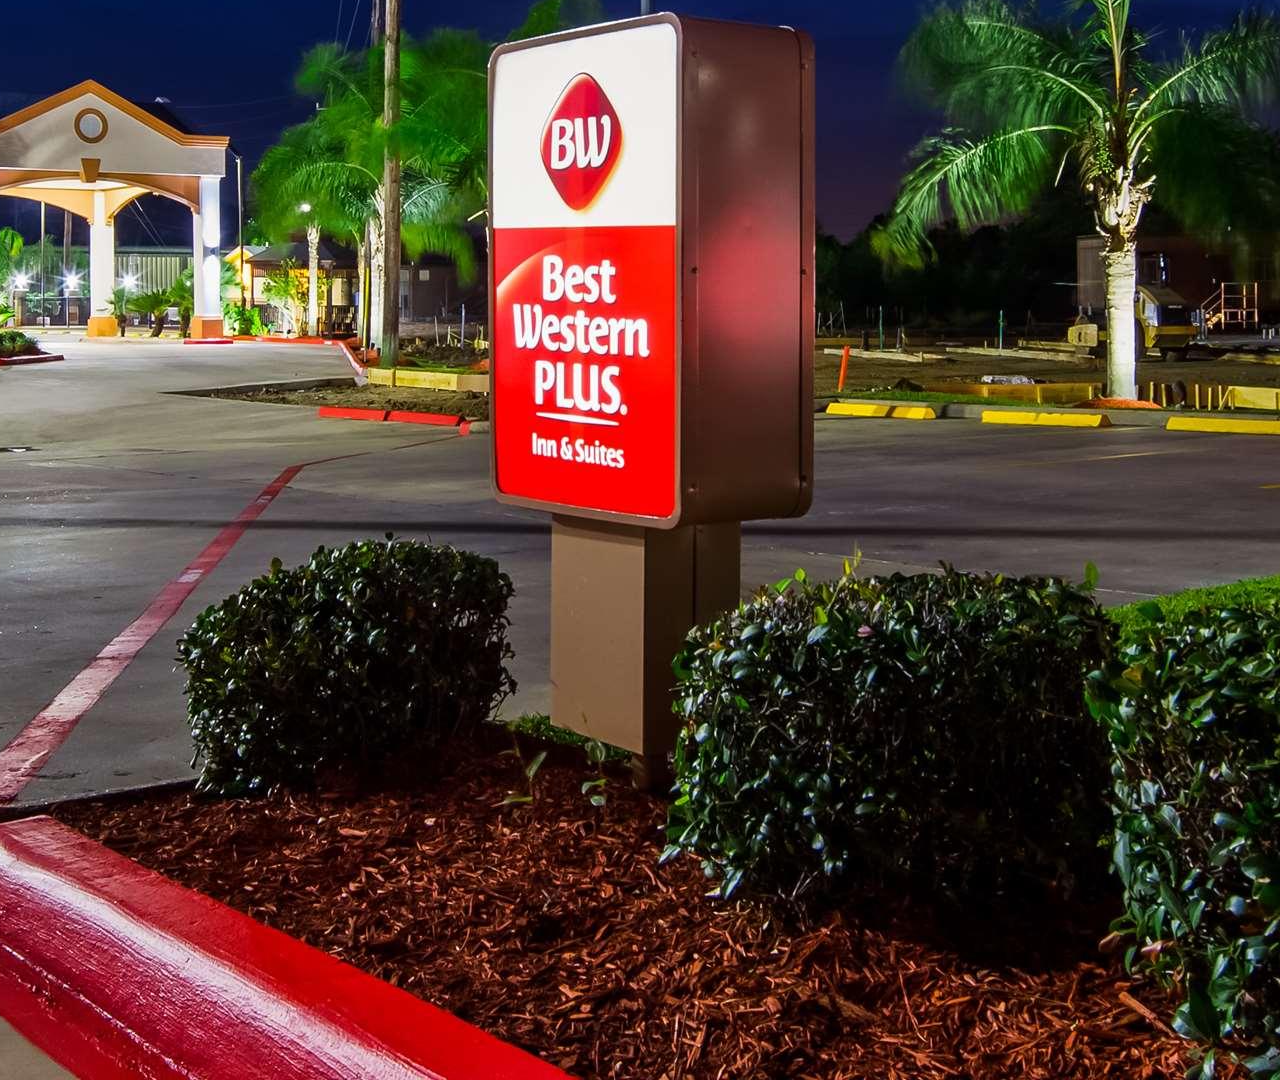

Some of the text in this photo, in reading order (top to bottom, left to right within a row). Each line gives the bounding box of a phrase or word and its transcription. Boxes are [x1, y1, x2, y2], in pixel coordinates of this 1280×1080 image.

[550, 115, 612, 170] BW
[541, 254, 616, 304] Best
[512, 304, 650, 358] Western
[531, 433, 625, 468] Inn & Suites
